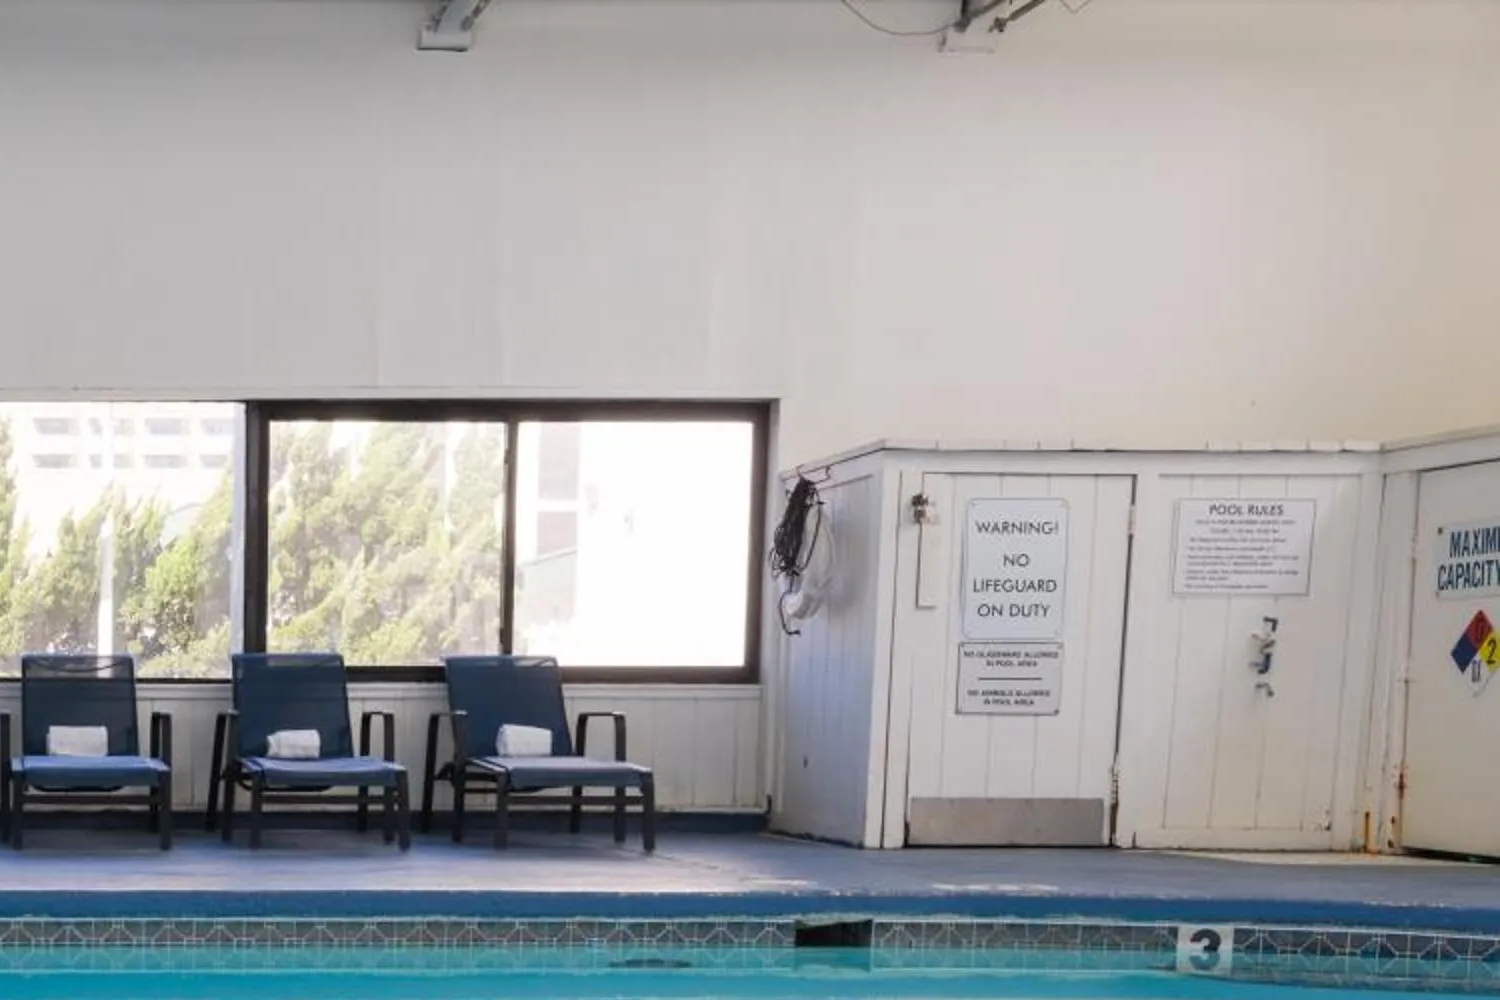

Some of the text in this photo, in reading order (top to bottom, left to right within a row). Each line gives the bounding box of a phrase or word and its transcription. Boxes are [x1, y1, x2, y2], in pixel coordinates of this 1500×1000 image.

[1208, 504, 1284, 515] POOL RULES
[975, 521, 1058, 535] WARNING!
[1003, 553, 1029, 567] NO
[973, 579, 1057, 593] LIFEGUARD
[977, 603, 1050, 617] ON DUTY
[1487, 638, 1497, 665] 2
